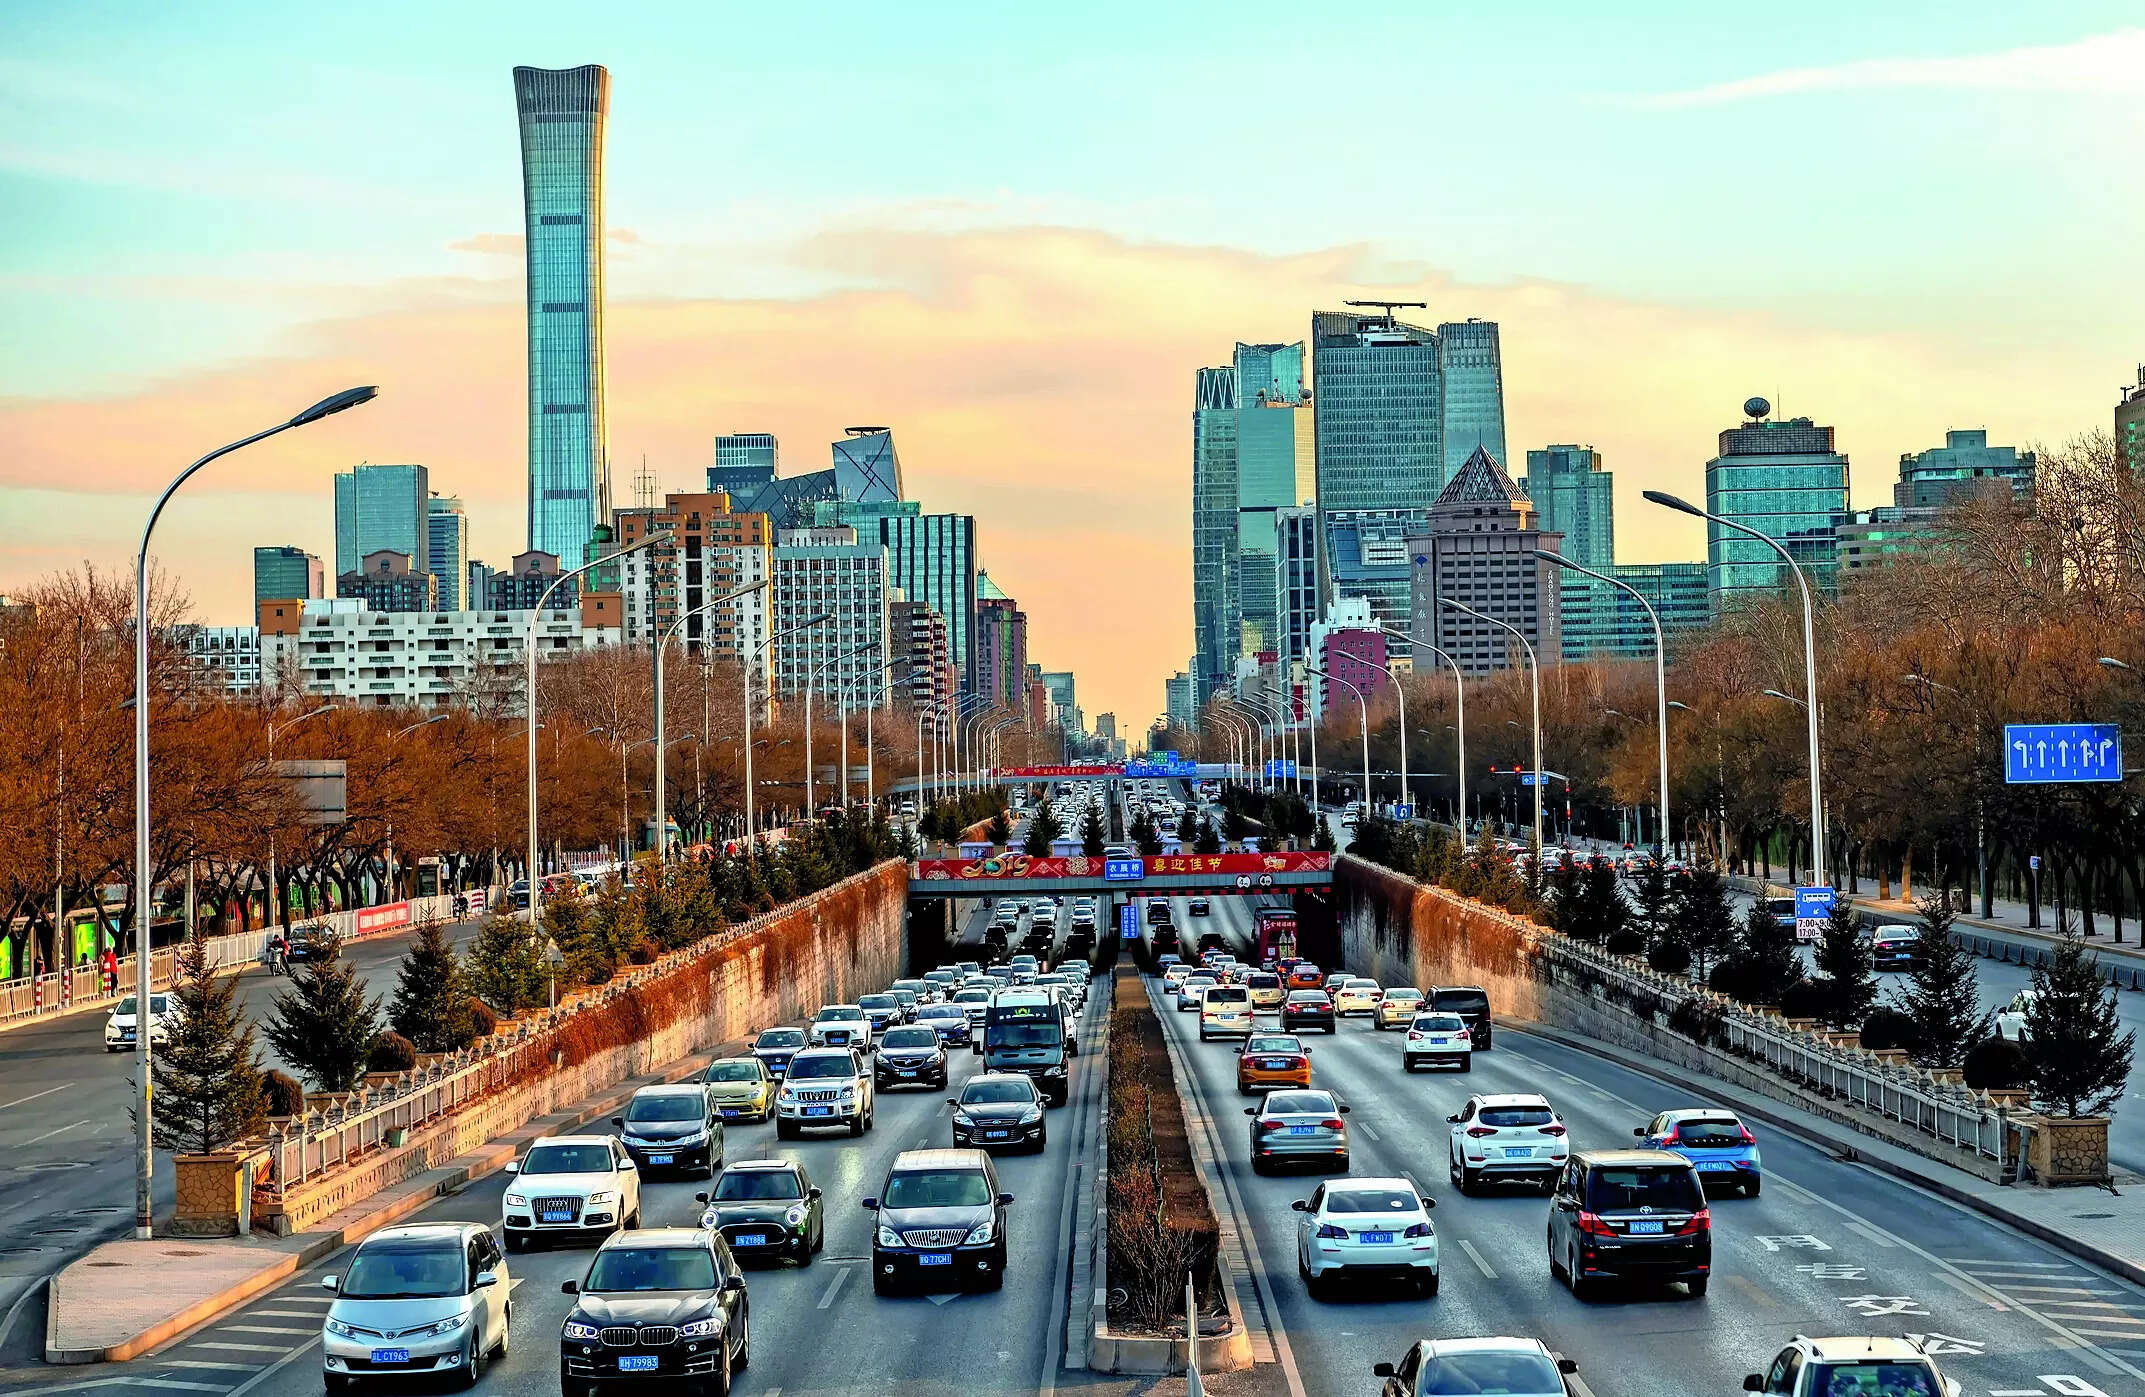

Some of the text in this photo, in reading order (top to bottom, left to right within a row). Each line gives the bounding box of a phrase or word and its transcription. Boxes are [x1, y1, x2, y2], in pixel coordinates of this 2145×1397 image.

[961, 854, 1034, 877] 2019
[1109, 863, 1140, 873] 农展桥
[1152, 857, 1223, 872] 喜迎佳节
